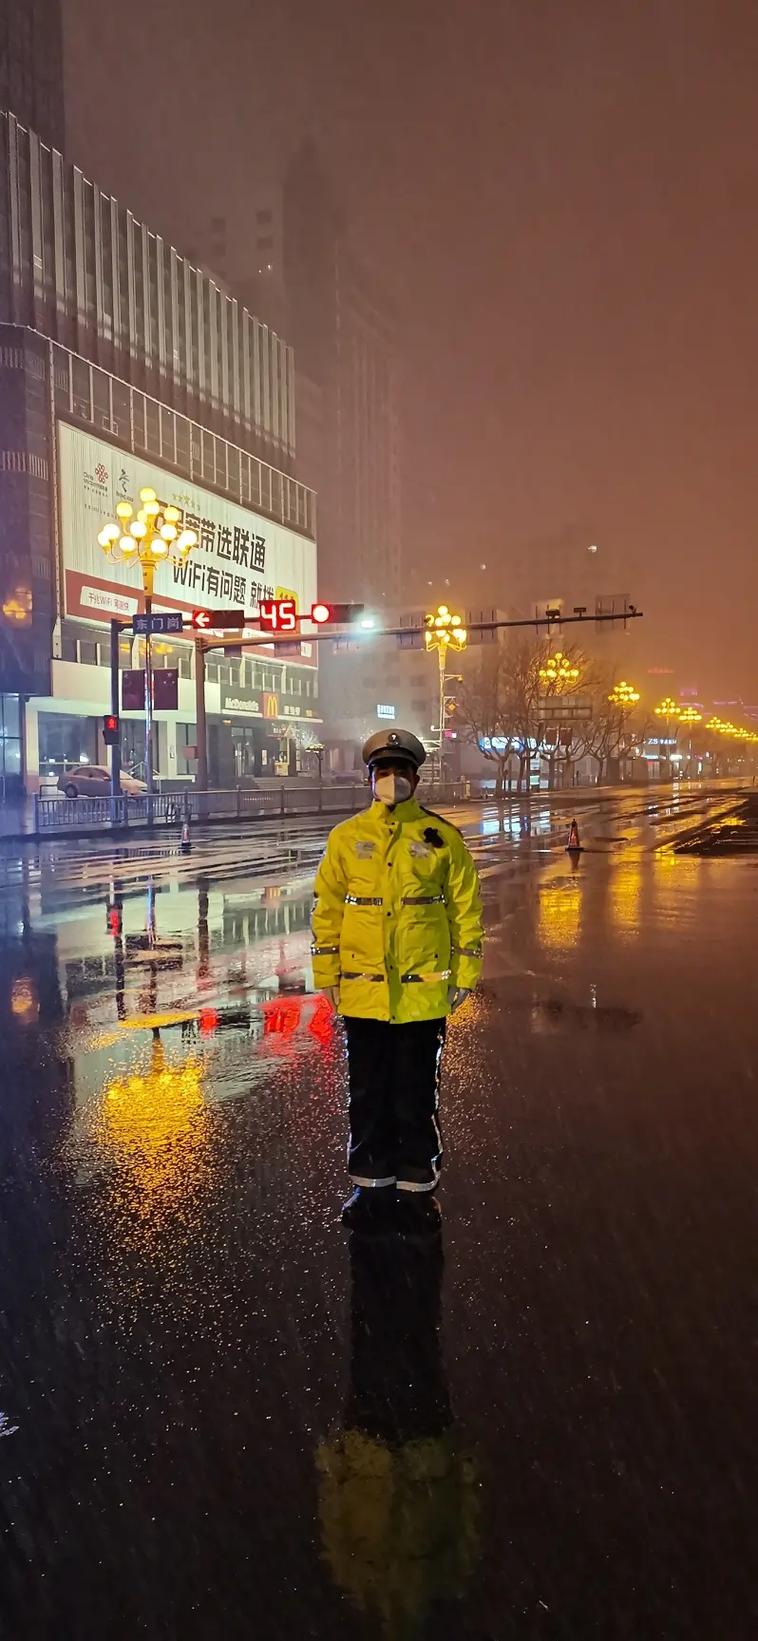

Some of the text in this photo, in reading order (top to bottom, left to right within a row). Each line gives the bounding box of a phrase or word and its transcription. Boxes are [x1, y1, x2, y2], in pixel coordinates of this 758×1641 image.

[154, 499, 266, 574] 宽带选联通
[136, 616, 180, 631] 东门岗
[260, 602, 296, 630] 45
